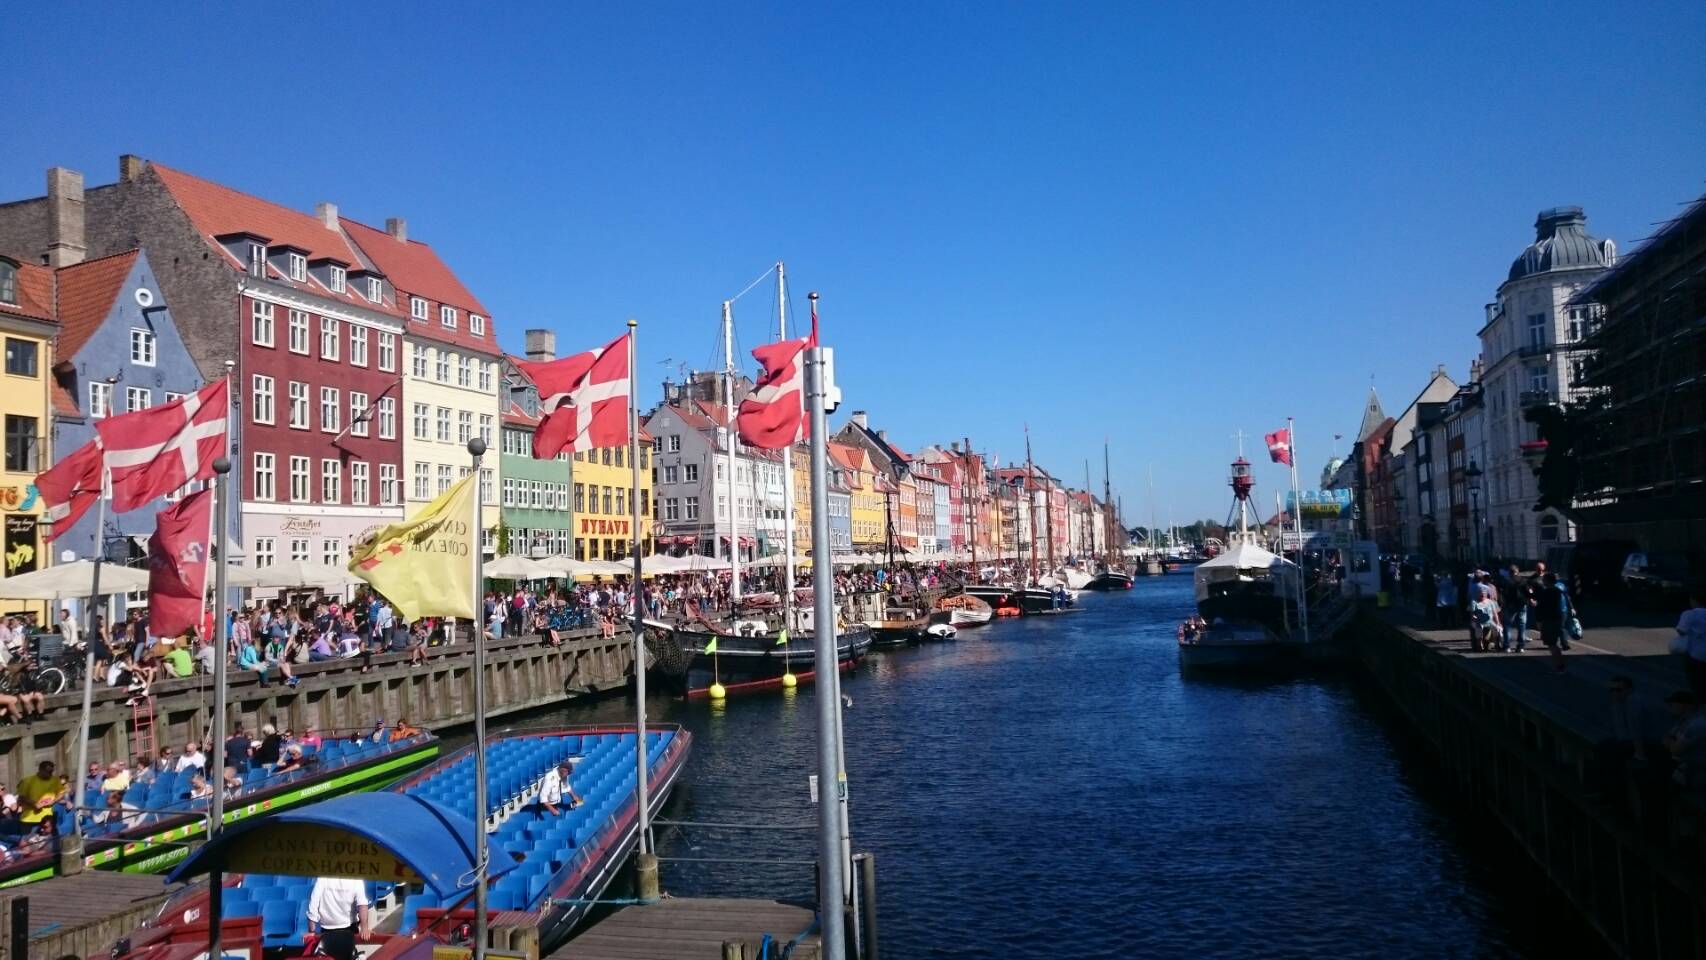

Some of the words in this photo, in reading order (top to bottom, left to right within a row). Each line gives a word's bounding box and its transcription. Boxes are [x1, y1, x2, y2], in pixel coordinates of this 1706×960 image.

[581, 519, 629, 535] NYHAVN
[263, 838, 319, 853] CANAL
[322, 840, 379, 856] TOURS
[262, 857, 381, 875] COPENHAGEN
